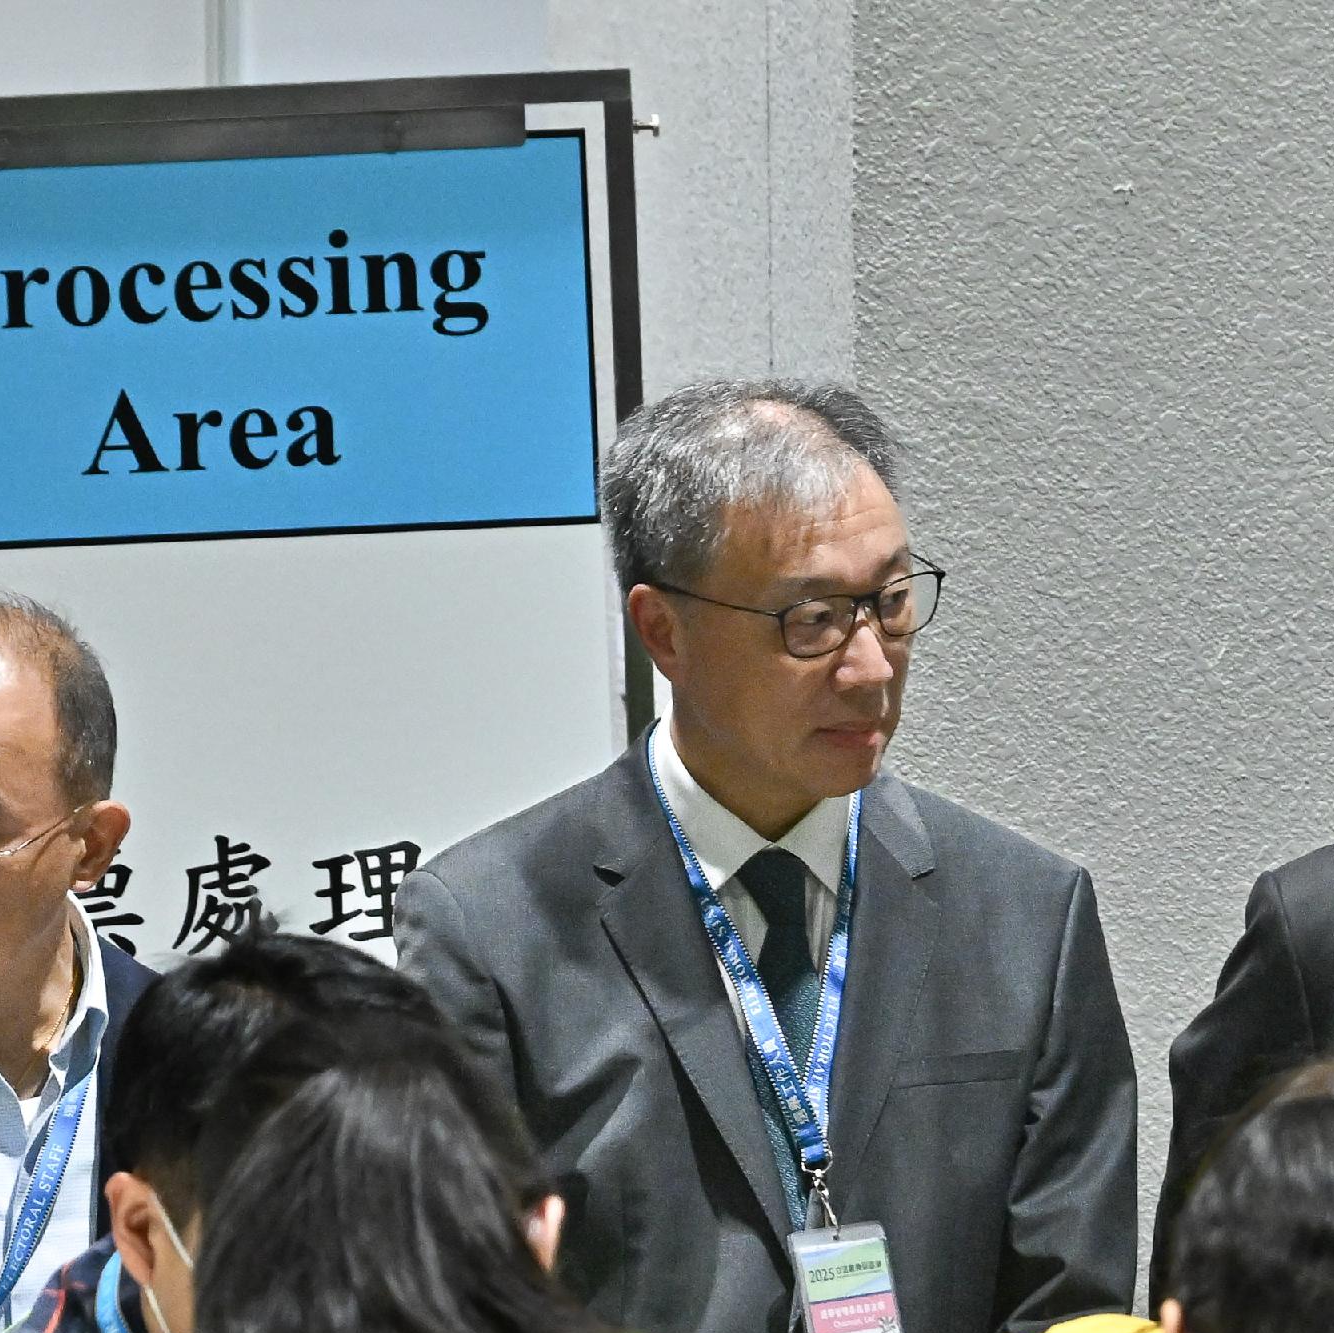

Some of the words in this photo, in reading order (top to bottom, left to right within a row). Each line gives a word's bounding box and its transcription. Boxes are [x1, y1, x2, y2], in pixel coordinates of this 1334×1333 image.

[82, 389, 341, 475] Area
[807, 1084, 824, 1118] STA
[38, 1143, 67, 1192] STAFF
[808, 1267, 835, 1284] 2025
